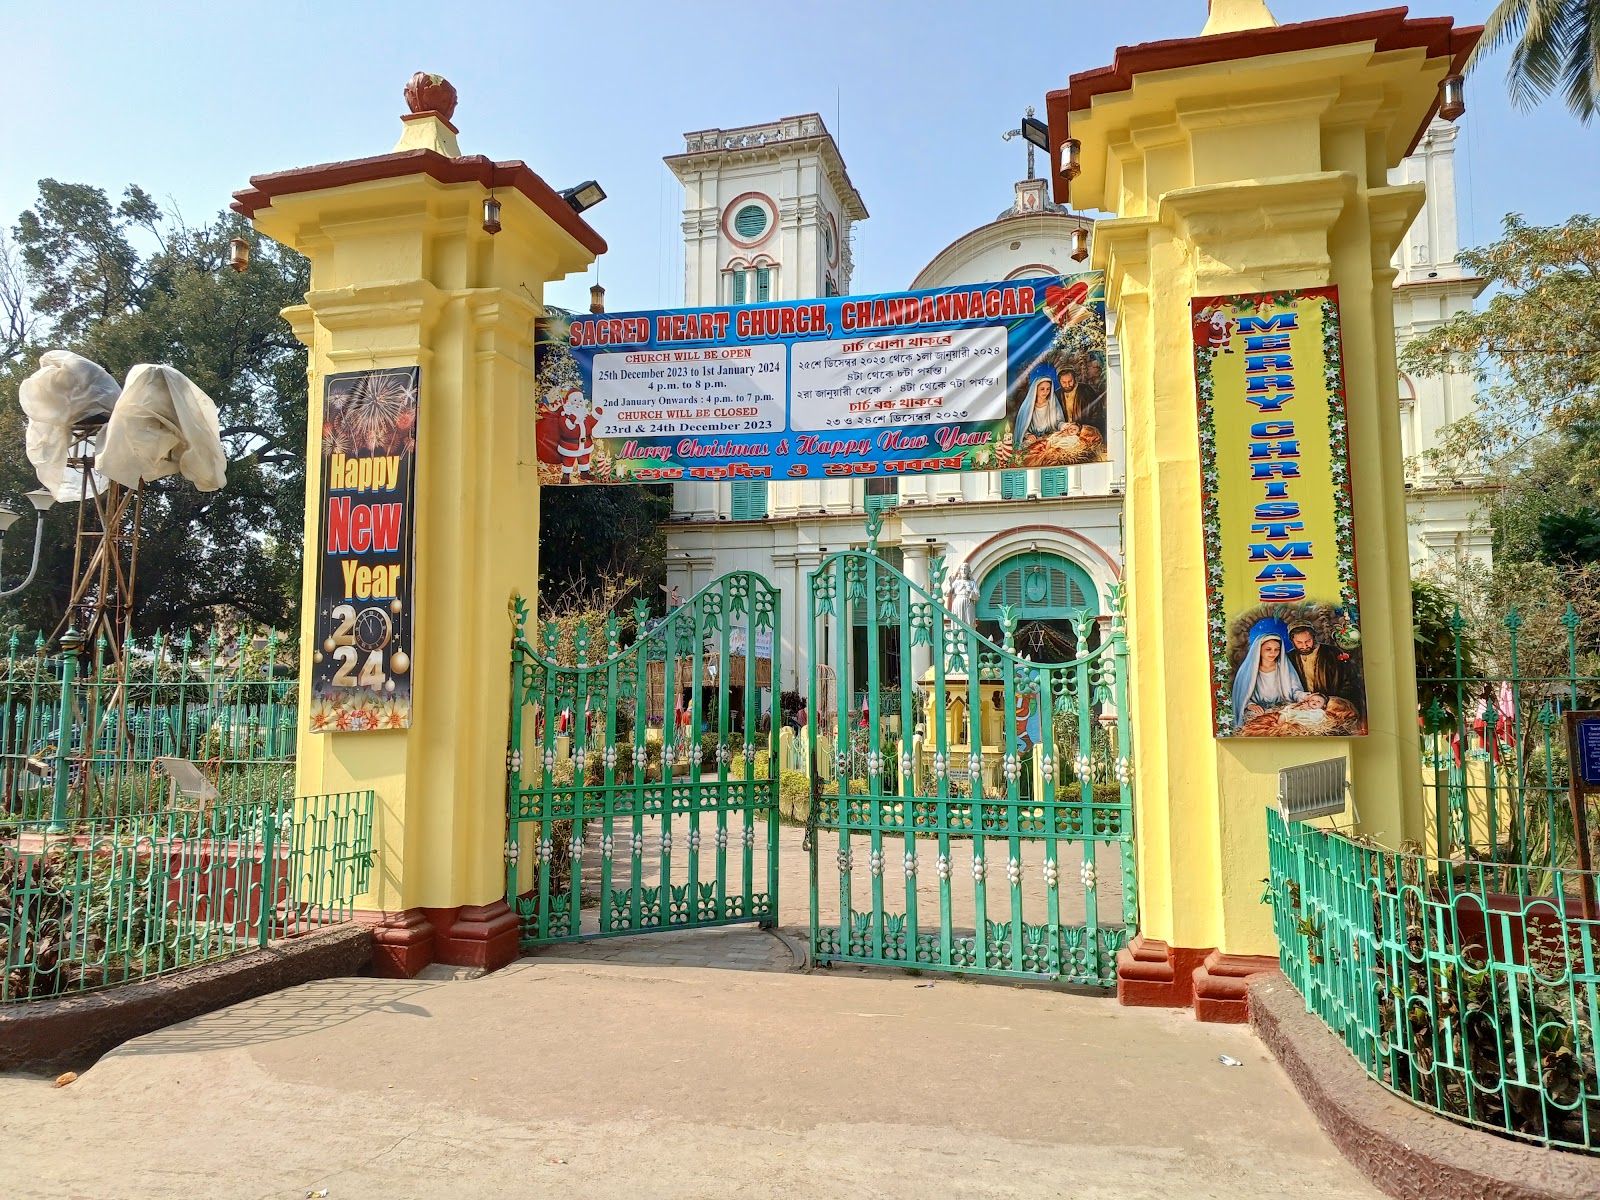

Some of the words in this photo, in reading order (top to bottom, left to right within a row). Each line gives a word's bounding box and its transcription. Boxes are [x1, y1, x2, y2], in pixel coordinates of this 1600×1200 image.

[569, 317, 650, 347] SACRED
[656, 312, 729, 342] HEART
[736, 304, 833, 337] CHURCH,
[841, 286, 1036, 329] CHANDANNAGAR
[842, 339, 864, 352] চার্চ
[868, 338, 904, 350] খোলা
[908, 335, 952, 346] থাকবে
[625, 353, 670, 363] CHURCH
[674, 351, 700, 361] WILL
[704, 350, 718, 359] BE
[721, 348, 751, 358] OPEN
[798, 360, 821, 370] ২৫শে
[824, 357, 857, 369] ডিসেম্বর
[860, 356, 886, 366] ২০২৩
[889, 353, 913, 364] থেকে
[916, 351, 932, 361] ১লা
[935, 346, 970, 361] জানুয়ারী
[973, 346, 1000, 356] ২০২৪
[1236, 312, 1299, 413] MERRY
[598, 370, 618, 380] 25th
[620, 369, 664, 379] December
[667, 367, 688, 378] 2023
[690, 368, 699, 376] to
[702, 366, 714, 376] 1st
[717, 365, 755, 376] January
[758, 362, 780, 373] 2024
[847, 371, 863, 381] ৪টা
[867, 370, 894, 380] থেকে
[897, 367, 913, 377] ৮টা
[648, 382, 654, 390] 4
[657, 383, 680, 392] p.m.
[695, 380, 701, 388] 8
[704, 381, 727, 390] p.m.
[797, 389, 812, 399] ২রা
[815, 386, 852, 399] জানুয়ারী
[855, 386, 881, 396] থেকে
[900, 382, 916, 392] ৪টা
[920, 381, 947, 391] থেকে
[950, 379, 966, 388] ৭টা
[603, 398, 619, 407] 2nd
[621, 398, 656, 407] January
[658, 396, 698, 405] Onwards
[706, 395, 711, 403] 4
[714, 396, 733, 405] p.m.
[736, 394, 744, 402] to
[747, 393, 752, 401] 7
[755, 394, 774, 403] p.m.
[849, 399, 871, 411] চার্চ
[874, 400, 896, 409] বন্ধ
[899, 397, 943, 408] থাকবে
[617, 410, 663, 420] CHURCH
[666, 410, 692, 418] WILL
[696, 409, 711, 417] BE
[713, 407, 758, 417] CLOSED
[826, 418, 840, 426] ২৩
[857, 416, 886, 426] ২৪শে
[889, 412, 931, 423] ডিসেম্বর
[936, 411, 968, 419] ২০২৩
[605, 425, 631, 434] 23rd
[635, 424, 645, 433] &
[650, 424, 675, 433] 24th
[679, 422, 740, 431] December
[743, 420, 772, 430] 2023
[615, 440, 672, 461] Merry
[677, 438, 770, 459] Christmas
[775, 439, 789, 455] &
[796, 434, 872, 458] Happy
[877, 430, 929, 450] New
[934, 426, 992, 450] Year
[330, 453, 400, 493] Happy
[633, 466, 685, 480] শুভ
[688, 463, 773, 480] বড়দিন
[787, 463, 809, 476] ও
[823, 460, 879, 476] শুভ
[883, 451, 969, 473] নববর্ষ
[1248, 420, 1313, 603] CHRISTMAS
[327, 496, 402, 555] New
[341, 559, 401, 601] Year
[332, 646, 386, 691] 24
